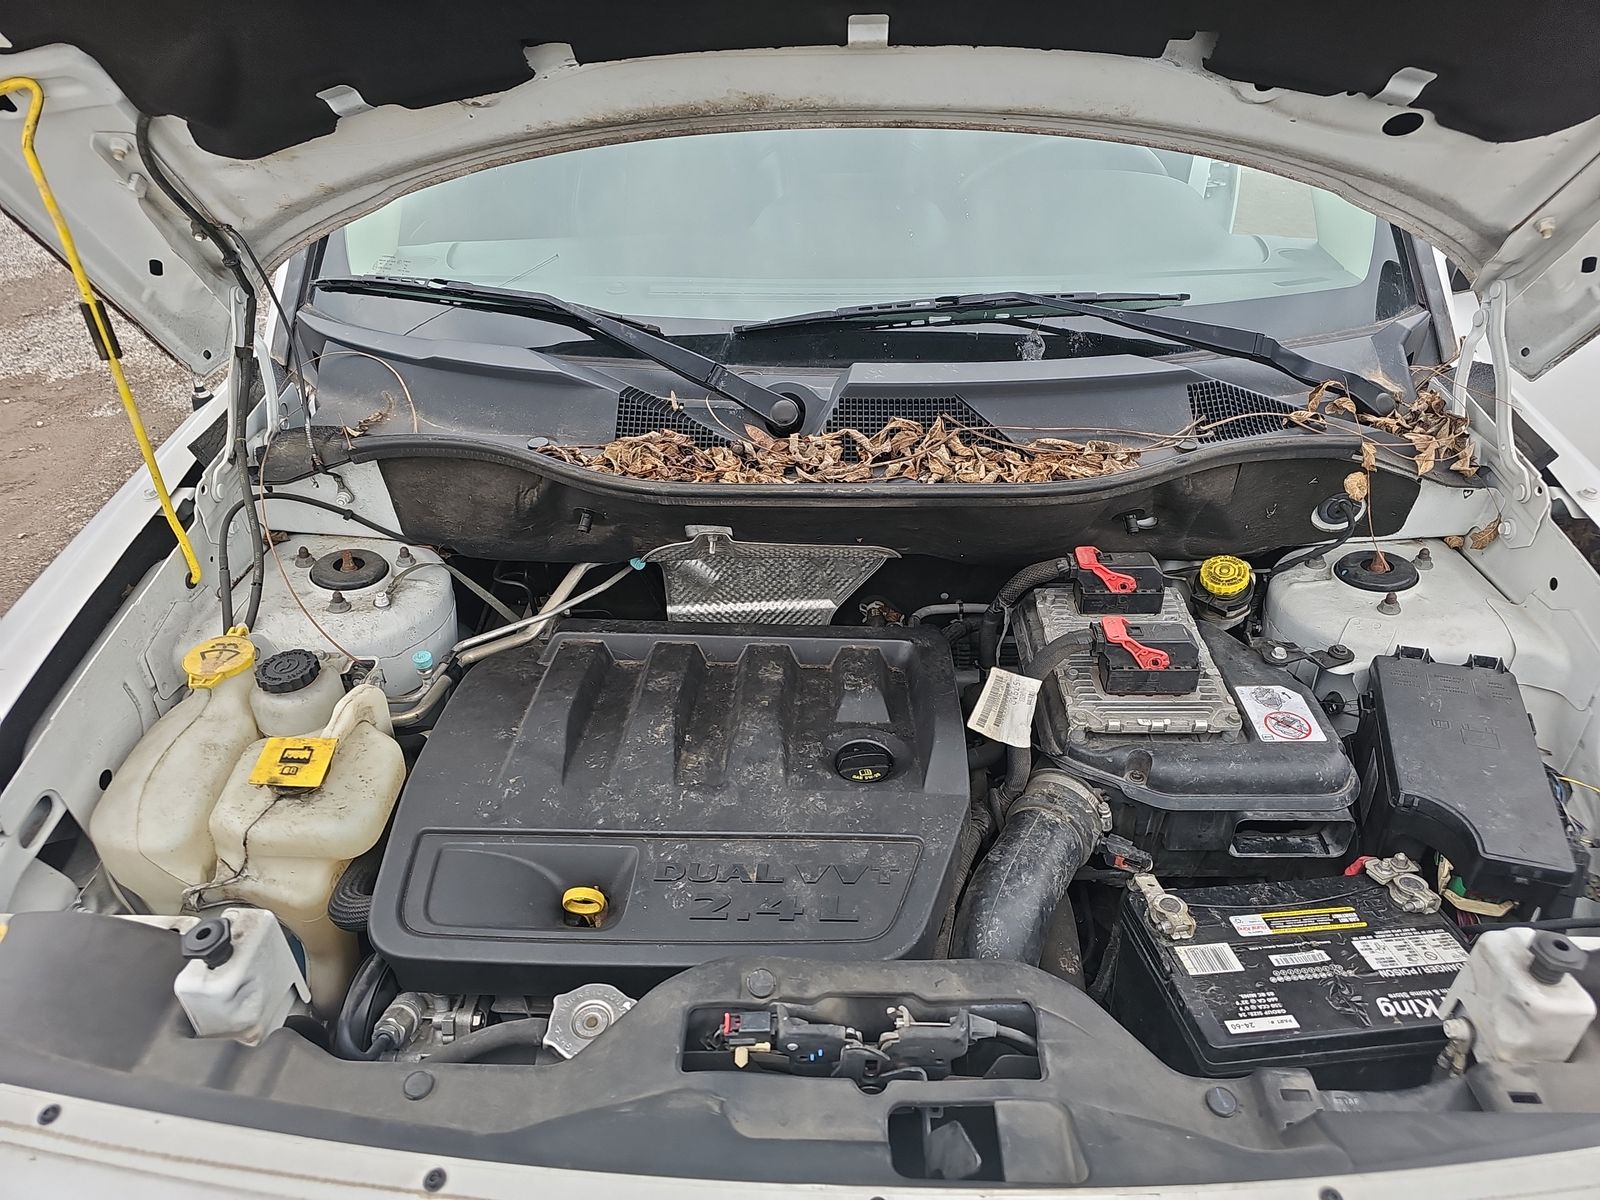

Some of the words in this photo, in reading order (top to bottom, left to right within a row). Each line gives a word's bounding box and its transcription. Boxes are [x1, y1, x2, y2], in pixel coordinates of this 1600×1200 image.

[653, 862, 785, 884] DUAL
[689, 893, 859, 922] 2.4L
[1387, 991, 1410, 999] Store
[1376, 997, 1443, 1020] King
[1230, 1022, 1255, 1030] 24-60
